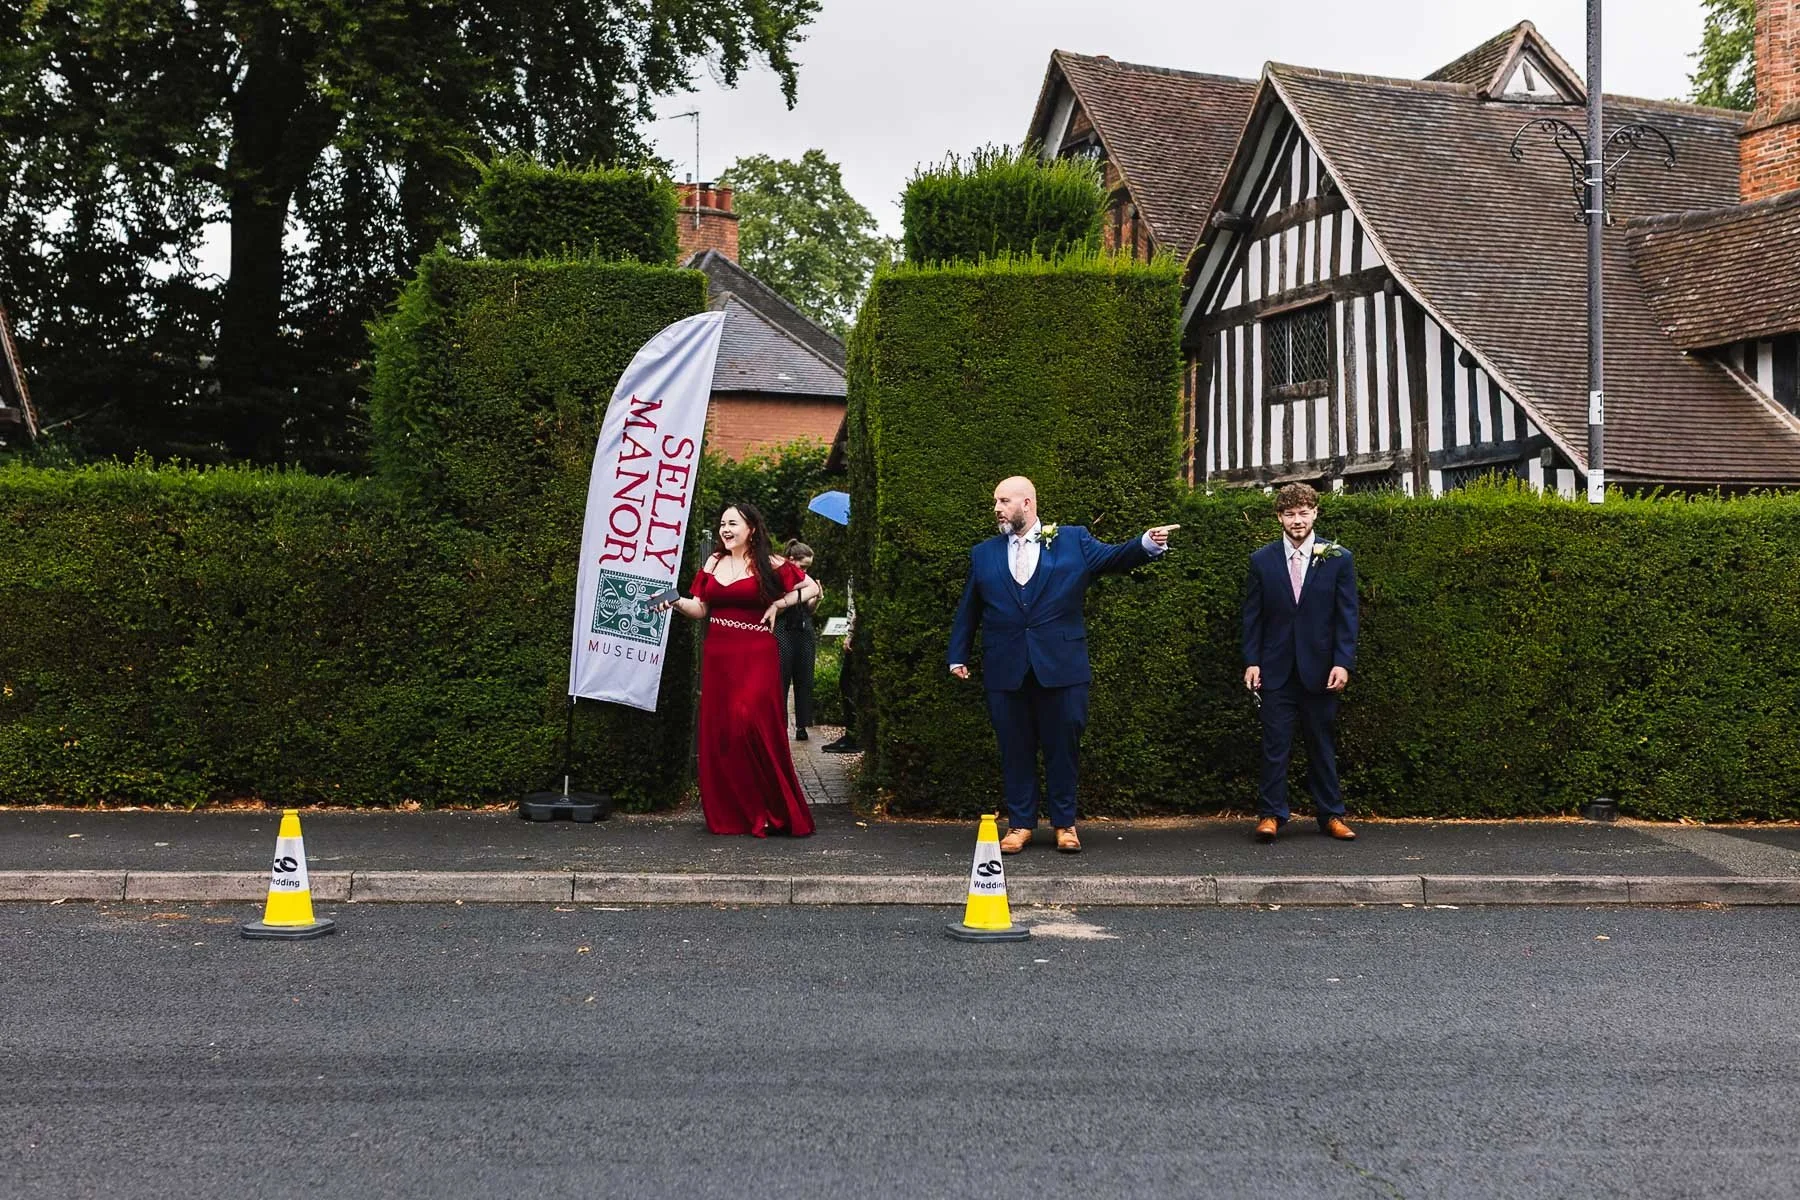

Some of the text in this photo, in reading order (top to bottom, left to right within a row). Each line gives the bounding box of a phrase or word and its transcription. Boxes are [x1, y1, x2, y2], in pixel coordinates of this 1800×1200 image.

[598, 394, 663, 565] MANOR
[643, 435, 695, 575] SELLY
[588, 639, 660, 665] MUSEUM
